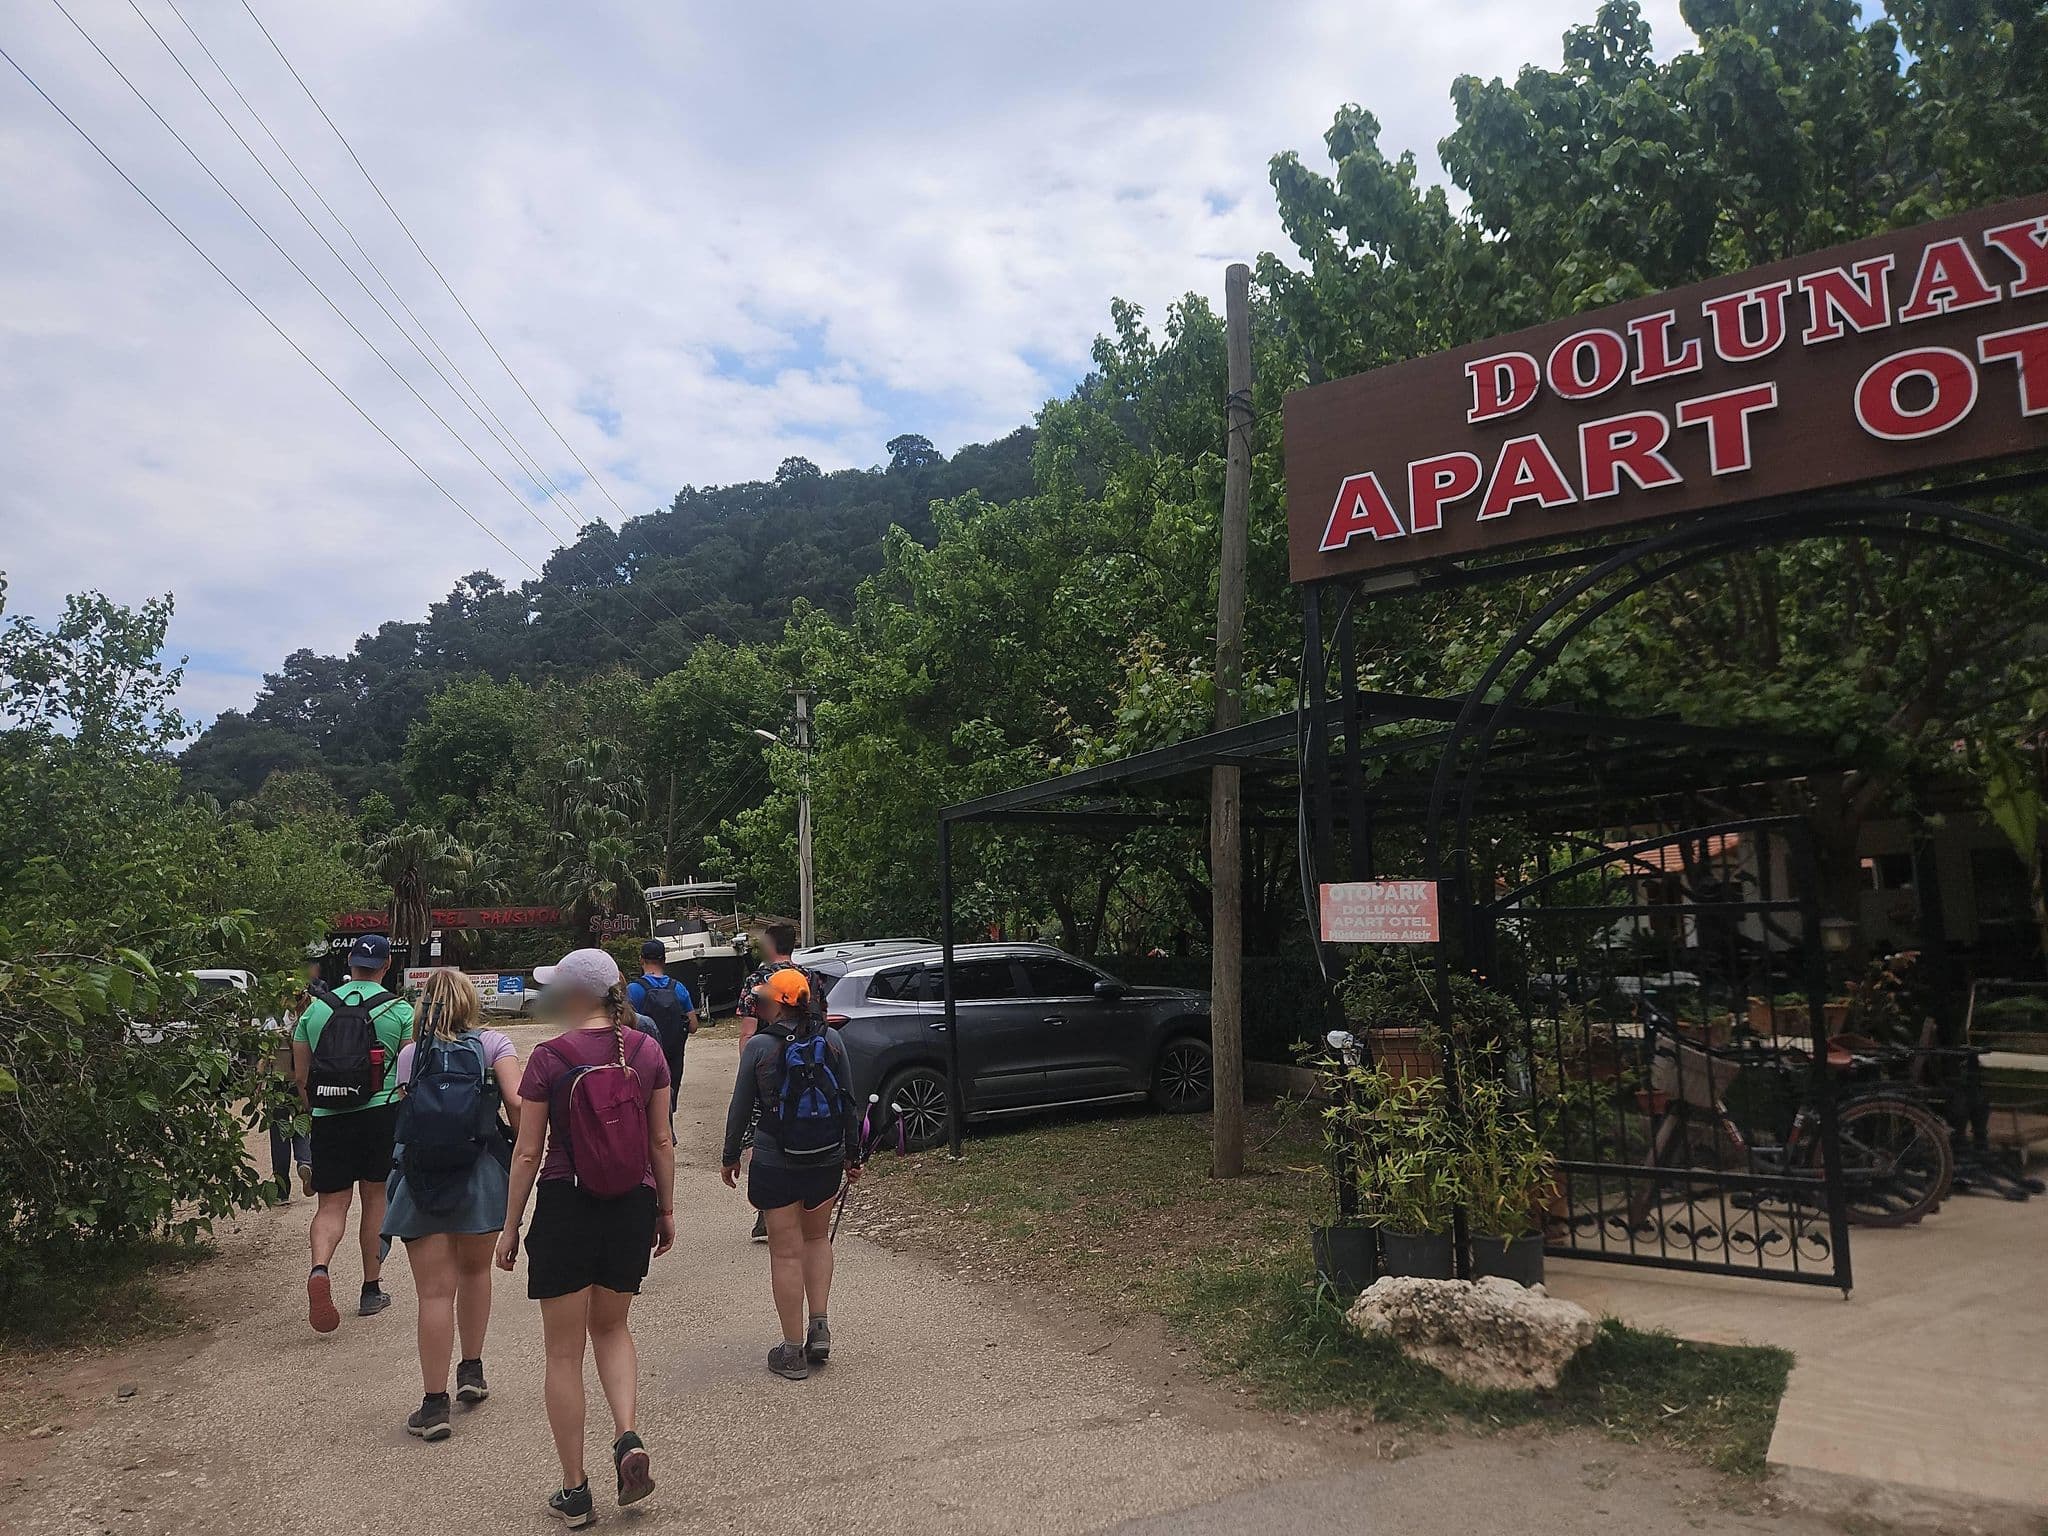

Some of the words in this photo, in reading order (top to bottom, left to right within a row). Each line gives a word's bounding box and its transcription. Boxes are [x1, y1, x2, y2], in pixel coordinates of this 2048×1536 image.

[1464, 214, 2048, 425] DOLUNAY
[1318, 382, 1778, 552] APART
[1330, 885, 1427, 901] OTOPARK
[1342, 904, 1420, 915] DOLUNAY
[1334, 917, 1385, 927] APART
[1389, 917, 1432, 927] OTEL
[317, 1085, 348, 1096] PUMA
